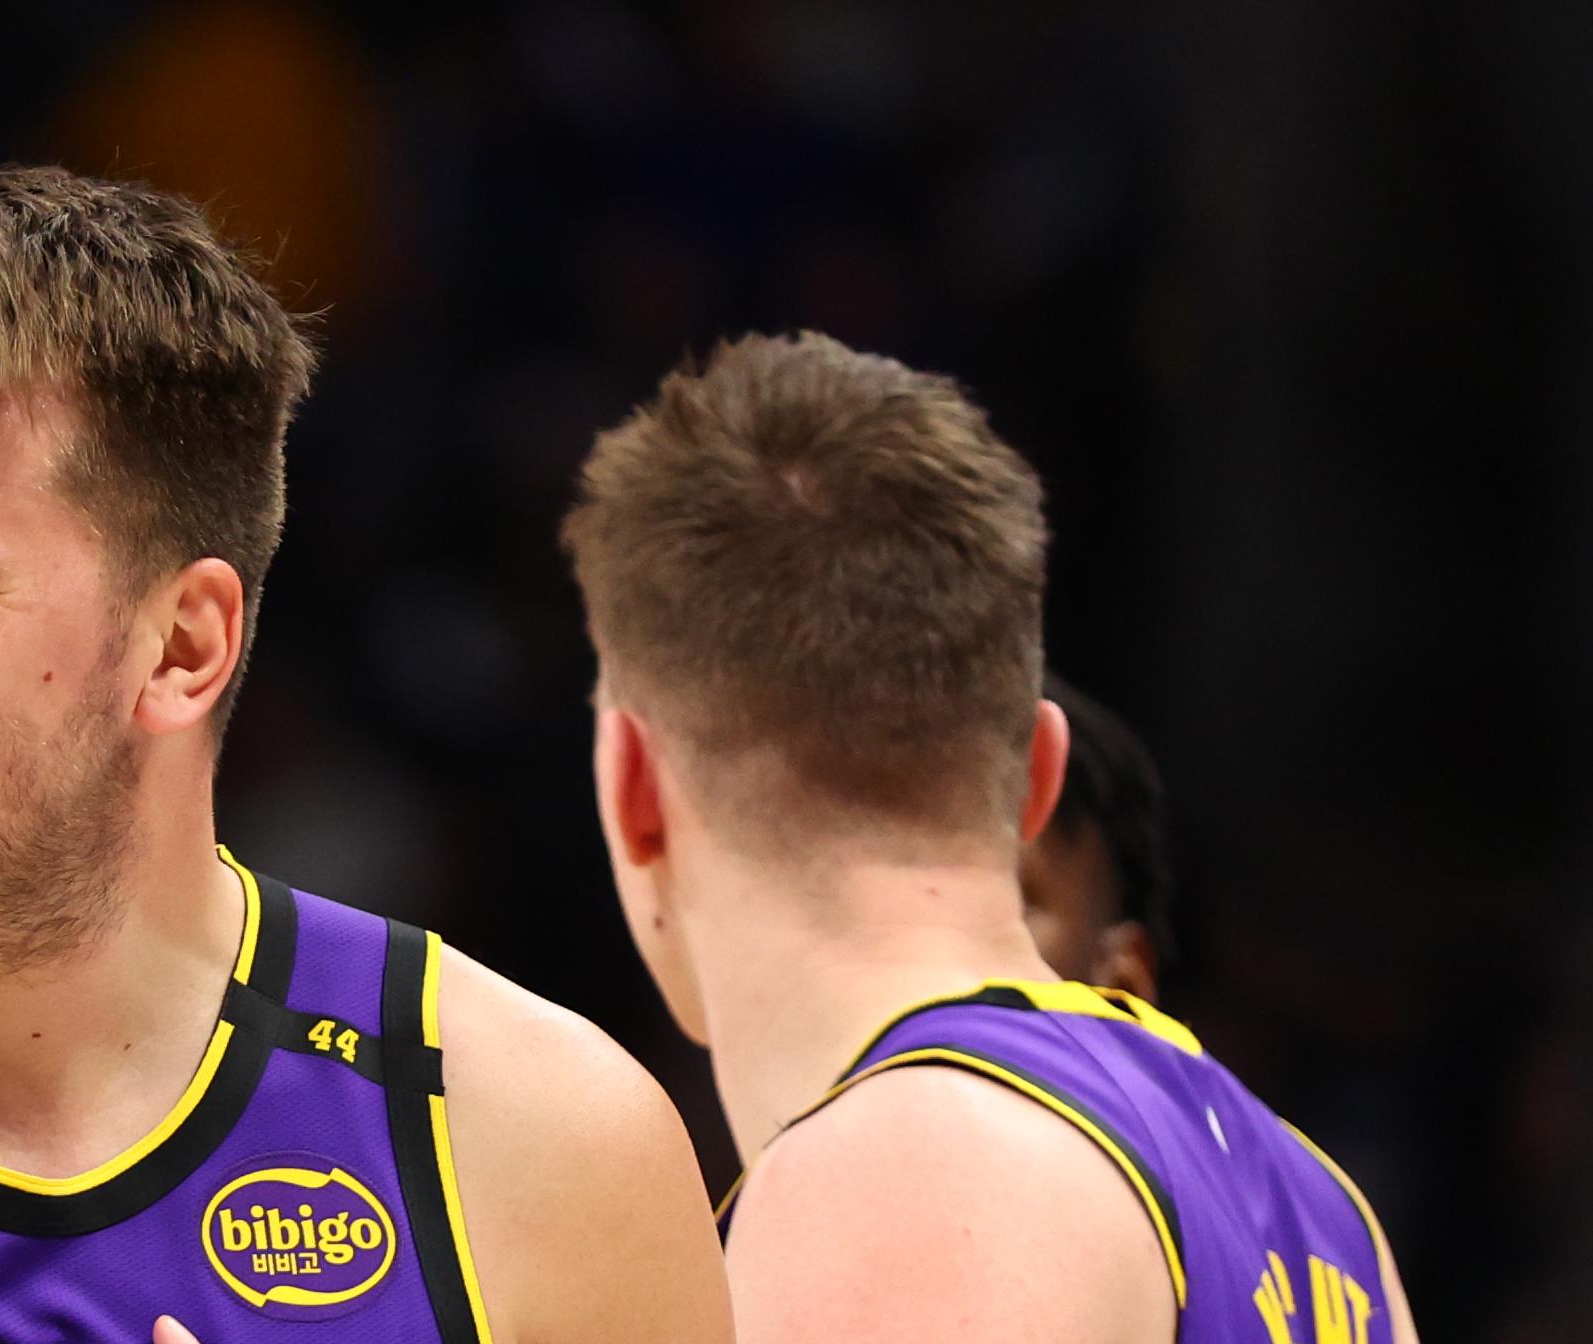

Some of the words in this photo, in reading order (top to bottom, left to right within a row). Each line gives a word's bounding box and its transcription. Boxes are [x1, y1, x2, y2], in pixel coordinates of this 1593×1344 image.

[307, 1019, 360, 1063] 44
[219, 1203, 382, 1264] bibigo
[252, 1252, 322, 1275] 비비고
